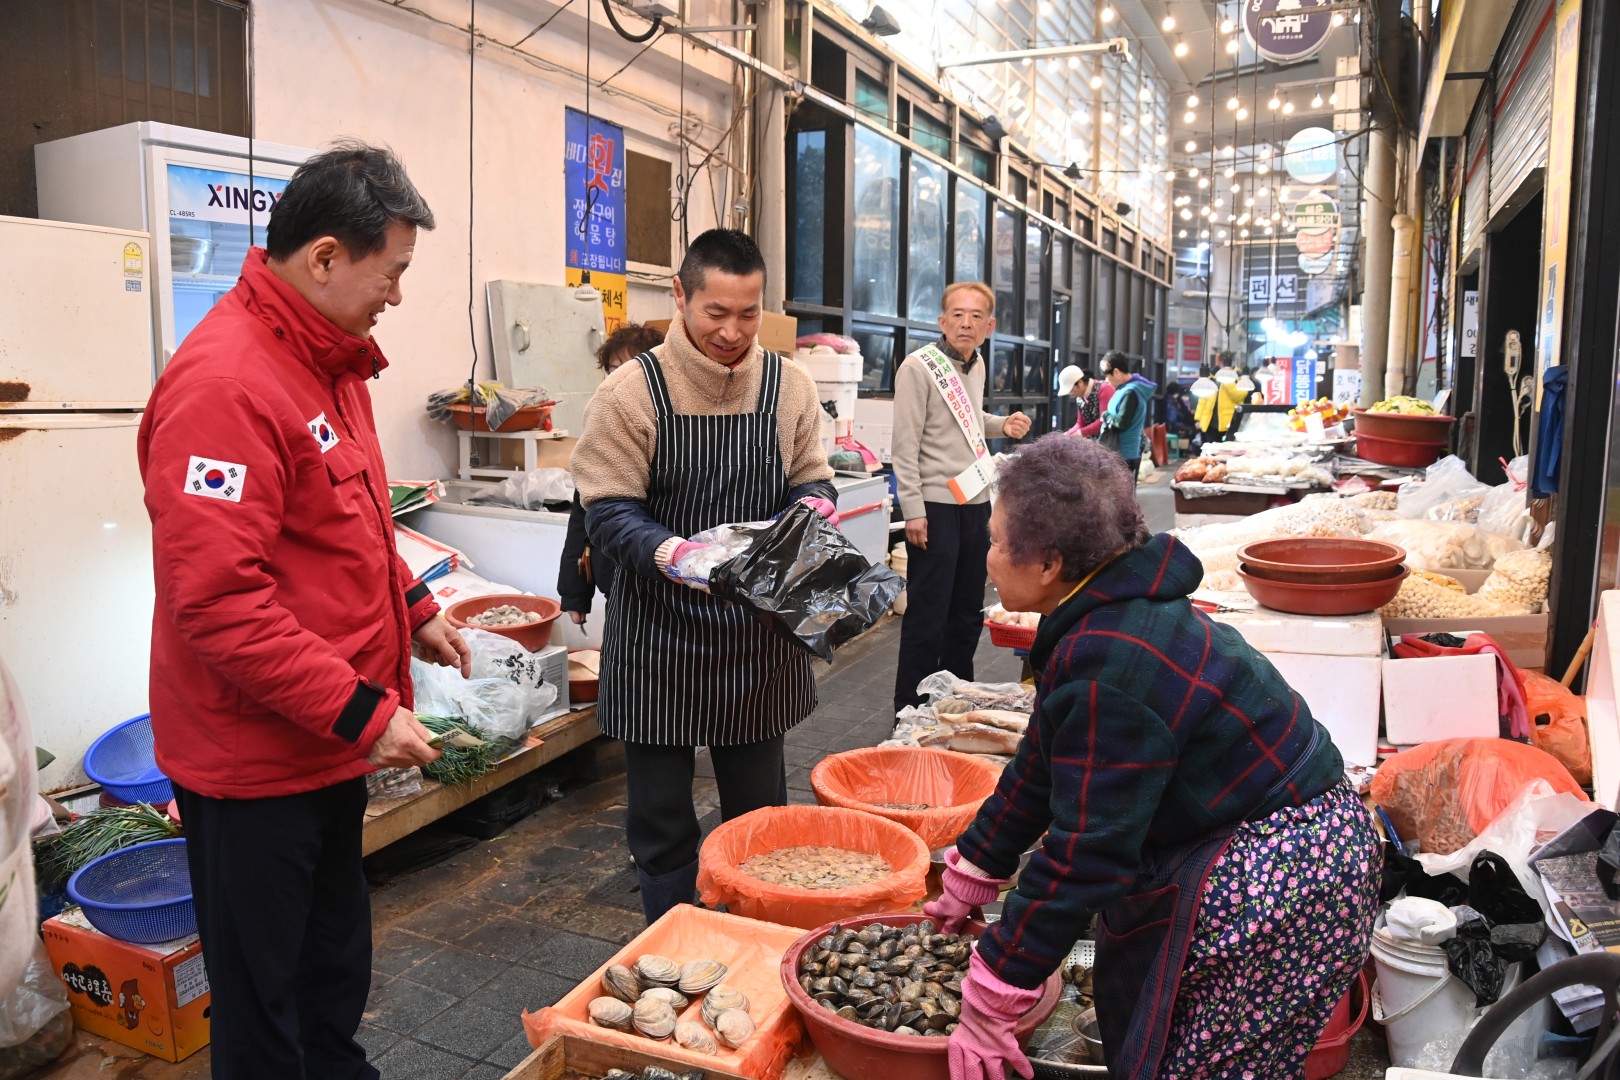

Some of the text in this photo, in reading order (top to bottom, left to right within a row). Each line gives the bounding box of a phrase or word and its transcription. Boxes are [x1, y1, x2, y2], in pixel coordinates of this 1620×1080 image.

[593, 286, 623, 309] 체석
[1251, 276, 1296, 300] 펜션
[919, 353, 949, 389] 전통시장
